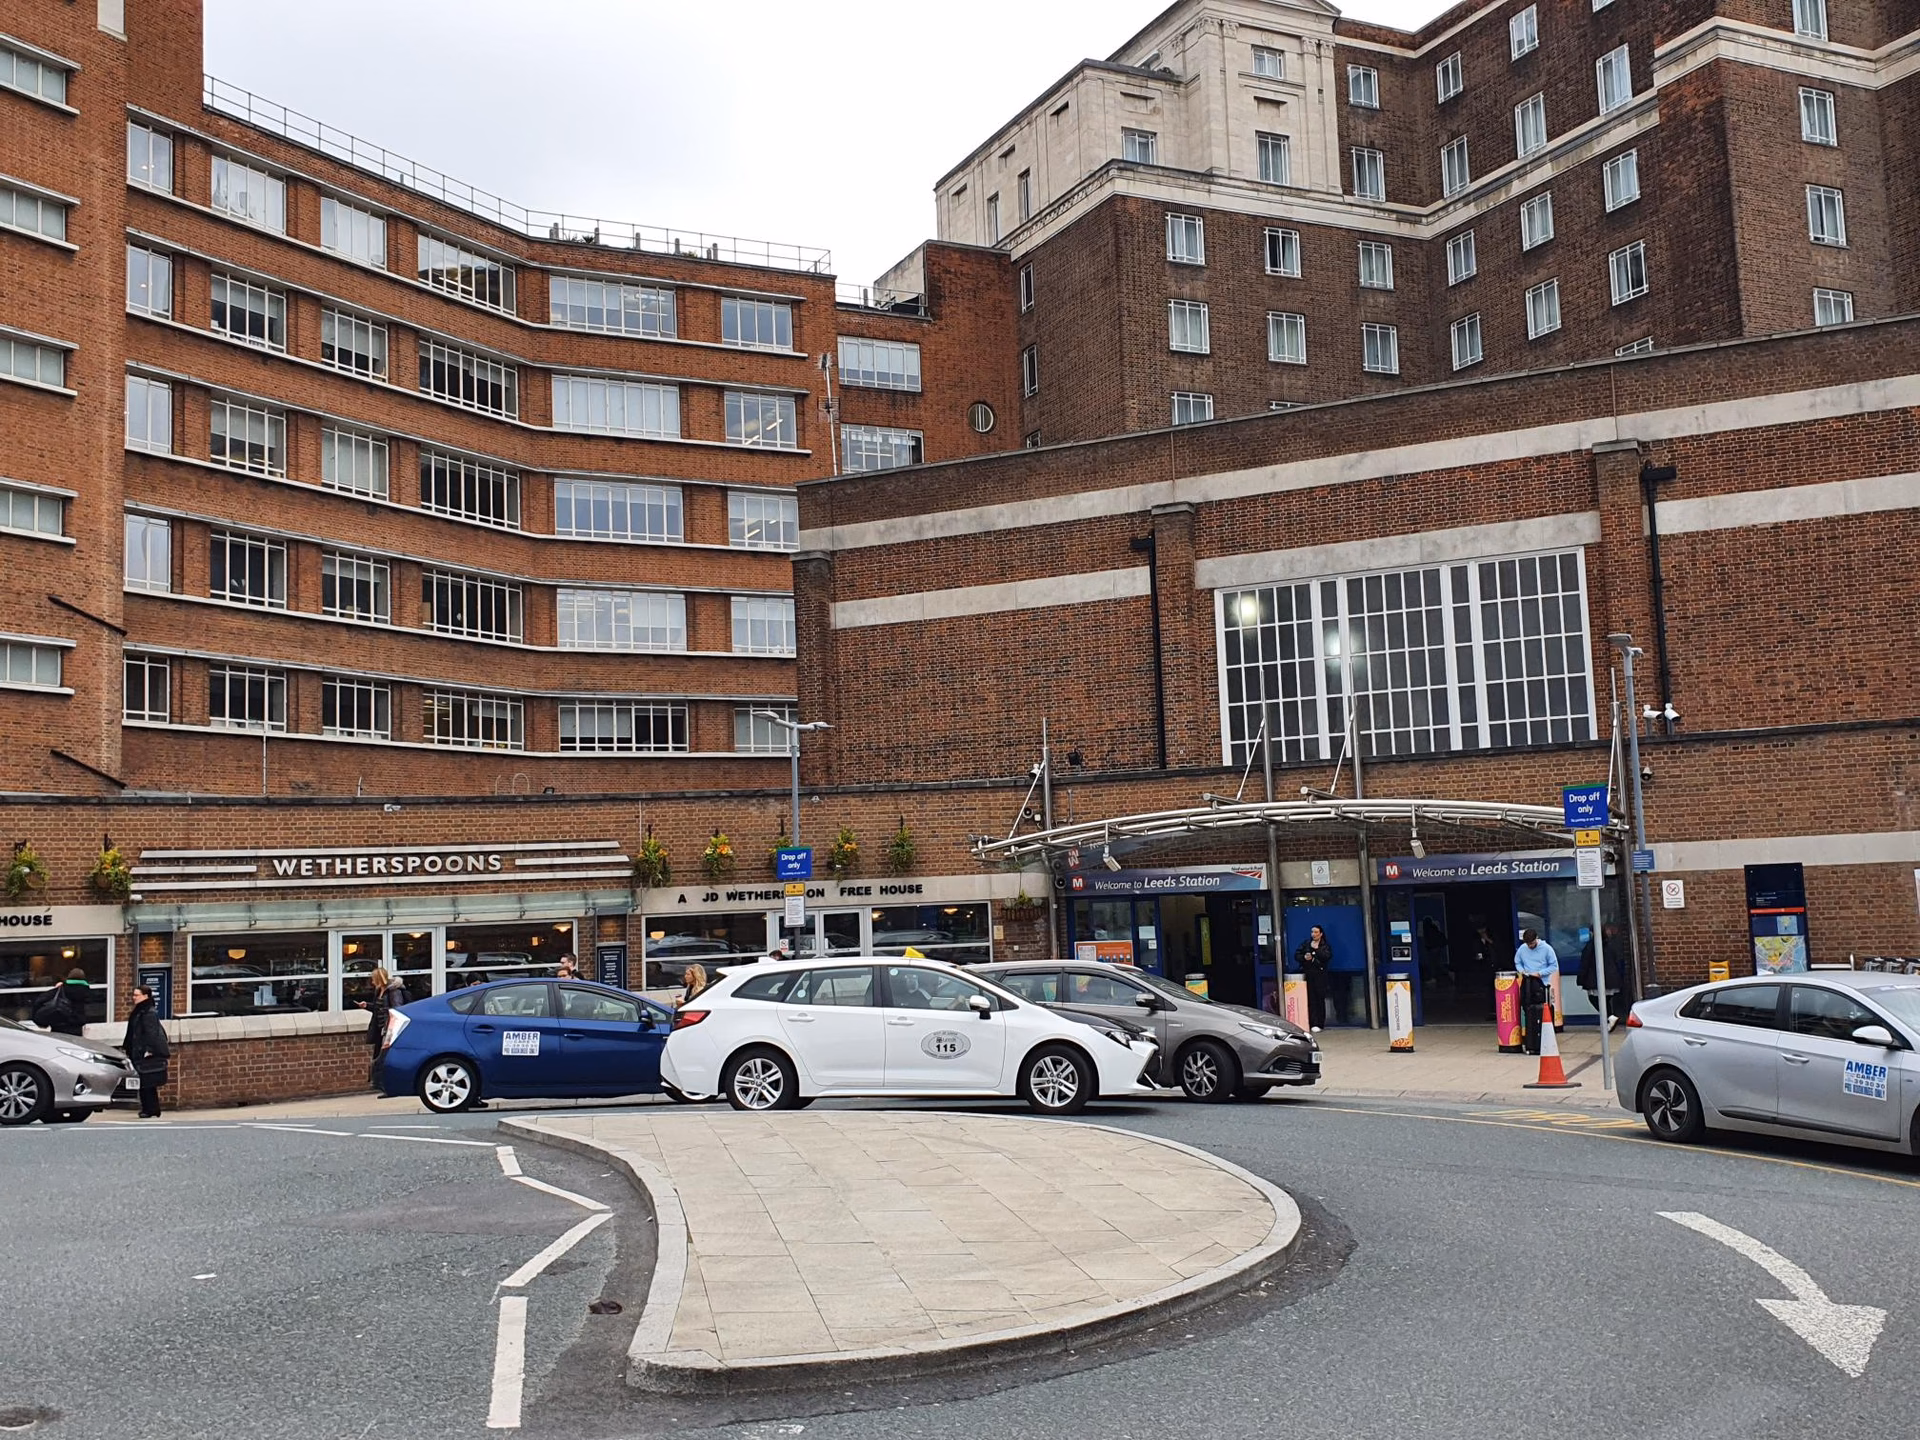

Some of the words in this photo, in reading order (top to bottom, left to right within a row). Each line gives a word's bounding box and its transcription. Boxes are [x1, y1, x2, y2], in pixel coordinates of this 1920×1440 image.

[1569, 793, 1587, 804] Drop
[1589, 791, 1601, 801] off
[1577, 804, 1594, 815] only
[781, 853, 796, 862] Drop
[797, 852, 807, 861] off
[273, 854, 502, 876] WETHERSPOONS
[787, 862, 801, 871] only
[1412, 867, 1456, 878] Welcome
[1457, 866, 1468, 876] to
[1470, 862, 1508, 876] Leeds
[1511, 860, 1560, 874] Station
[1095, 880, 1132, 890] Welcome
[1133, 880, 1142, 889] to
[1144, 876, 1176, 889] Leeds
[1178, 875, 1220, 888] Station
[677, 893, 688, 904] A
[702, 892, 719, 902] JD
[840, 886, 872, 897] FREE
[879, 884, 923, 895] HOUSE
[0, 914, 53, 927] HOUSE
[505, 1032, 539, 1041] AMBER
[935, 1043, 957, 1053] 115
[1845, 1060, 1887, 1078] AMBER
